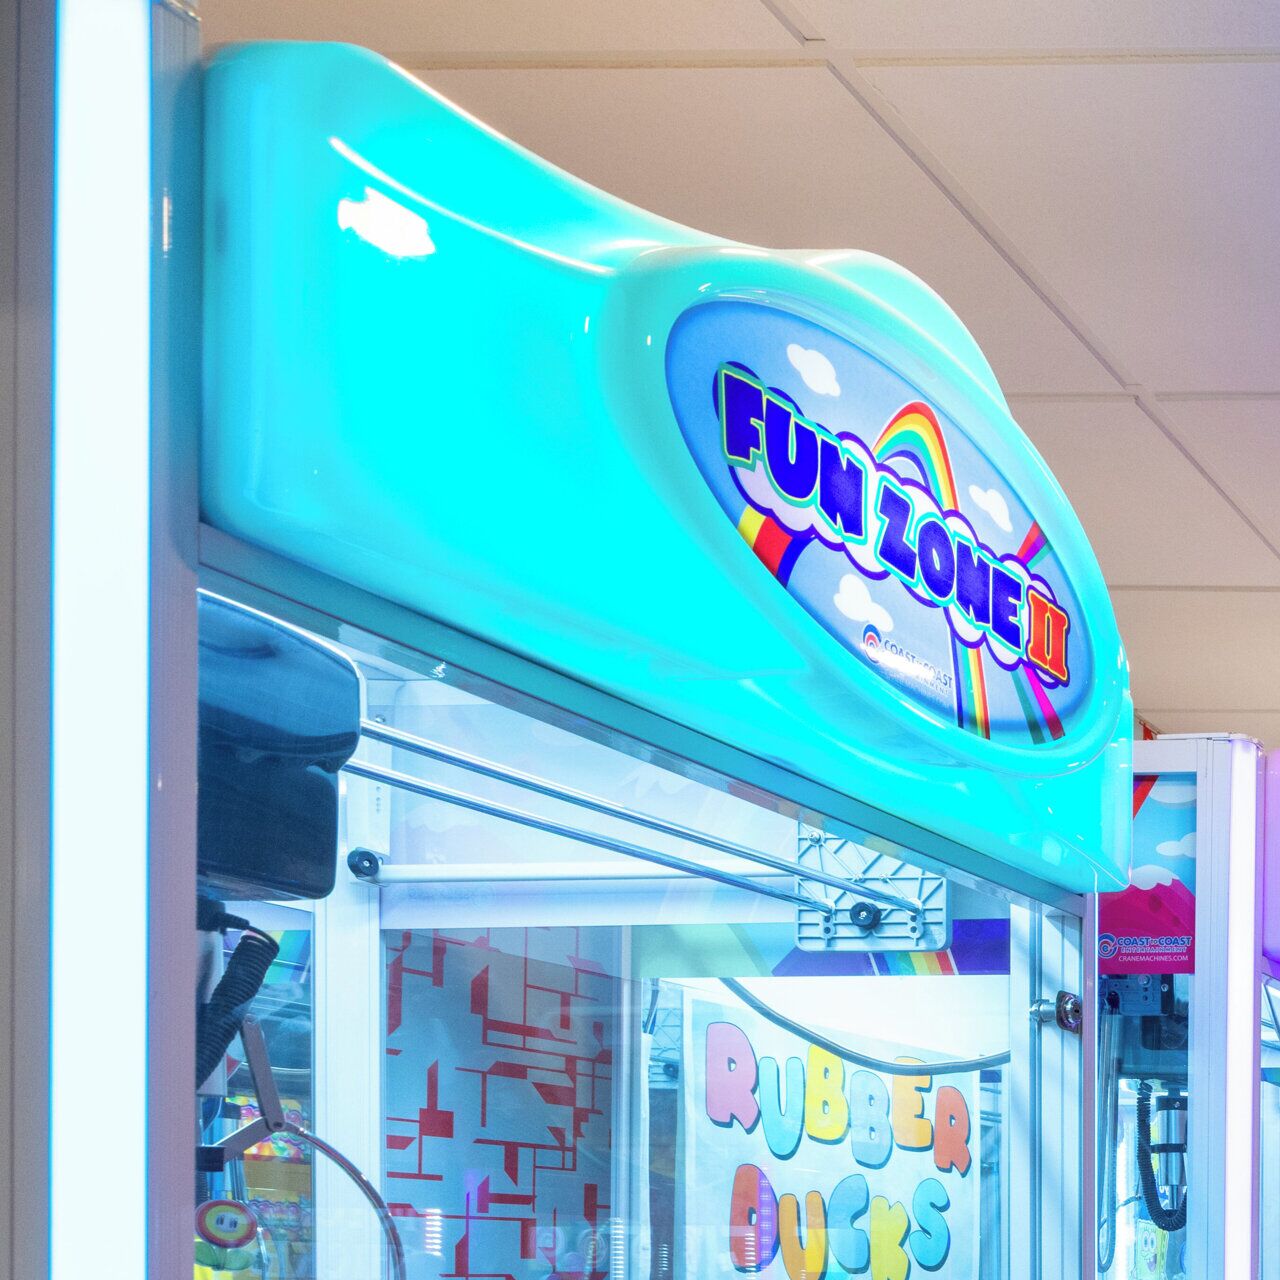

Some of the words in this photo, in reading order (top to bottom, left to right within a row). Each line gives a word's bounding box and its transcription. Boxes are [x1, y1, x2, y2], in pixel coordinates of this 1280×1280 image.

[717, 362, 868, 546] FUN
[876, 475, 1025, 656] ZONE
[1026, 587, 1070, 688] II
[1117, 936, 1151, 947] COAST
[1158, 936, 1193, 947] COAST
[705, 1021, 972, 1178] RUBBER
